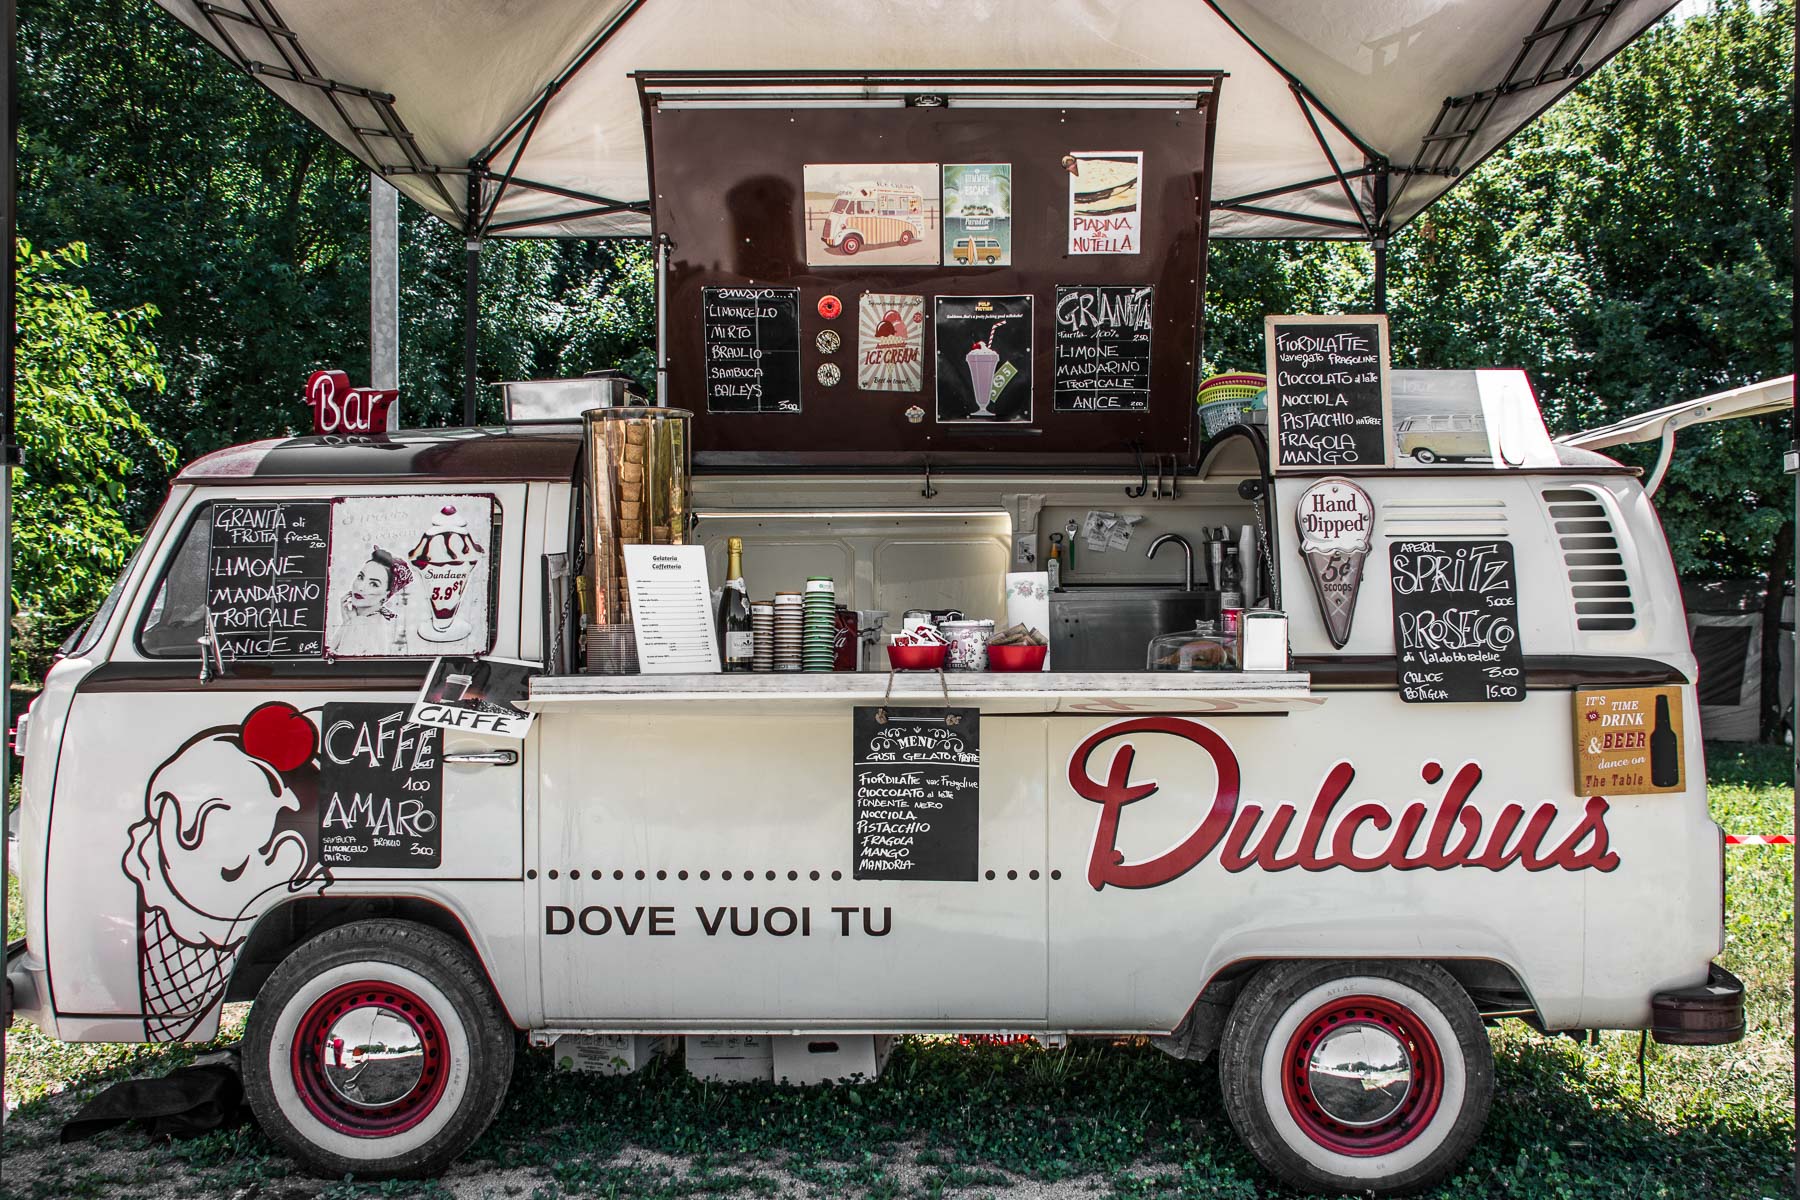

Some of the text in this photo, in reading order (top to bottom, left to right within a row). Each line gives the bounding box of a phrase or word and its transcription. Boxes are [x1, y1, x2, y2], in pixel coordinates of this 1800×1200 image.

[1074, 217, 1133, 232] PIADINA
[1073, 235, 1132, 252] NUTELLA
[709, 304, 778, 319] LIMONCELLO
[1057, 287, 1152, 331] GRANITA
[711, 325, 751, 338] MIRTO
[1276, 333, 1368, 352] FIORDILATTE
[712, 345, 762, 359] BRAULIO
[865, 348, 919, 365] ICE CREAM
[1060, 344, 1119, 359] LIMONE
[712, 367, 763, 379] SAMBUCA
[1057, 360, 1140, 376] MANDARINO
[1058, 379, 1134, 390] TROPICALE
[1278, 371, 1352, 387] CIOCCOLATO
[714, 384, 762, 400] BAILEYS
[312, 374, 383, 431] Bar
[1073, 396, 1121, 409] ANICE
[1282, 393, 1348, 407] NOCCIOLA
[1281, 412, 1353, 430] PISTACCHIO
[1280, 431, 1356, 450] FRAGOLA
[1282, 450, 1359, 465] MANGO
[1312, 494, 1357, 513] Hand
[215, 507, 286, 531] GRANITA
[1307, 513, 1364, 539] Dipped
[229, 527, 278, 543] FRUTTA
[1400, 542, 1446, 553] APEROL
[215, 555, 305, 577] LIMONE
[1322, 556, 1351, 583] 5¢
[212, 580, 320, 605] MANDARINO
[1323, 583, 1352, 594] scoops
[211, 607, 309, 628] TROPICALE
[1398, 608, 1515, 651] PROSECCO
[220, 637, 291, 654] ANICE
[1403, 671, 1444, 684] CALICE
[1586, 696, 1606, 706] IT'S
[1611, 701, 1638, 711] TIME
[1601, 713, 1644, 727] DRINK
[897, 736, 937, 749] MENU
[1587, 732, 1646, 754] & BEER
[903, 752, 950, 761] GELATO
[1598, 756, 1646, 770] dance on
[859, 772, 924, 785] FIORDILATTE
[1585, 773, 1643, 787] The Table
[858, 787, 924, 798] CIOCCOLATO
[857, 798, 943, 809] FONDENTE NERO
[1069, 717, 1621, 891] Dulcibus
[322, 792, 438, 838] AMARO
[860, 810, 917, 820] NOCCIOLA
[856, 820, 930, 834] PISTACCHIO
[861, 835, 913, 846] FRAGOLA
[324, 853, 351, 862] MIRTO
[860, 847, 909, 858] MANGO
[859, 859, 915, 871] MANDORLA
[545, 905, 892, 937] DOVE VUOI TU
